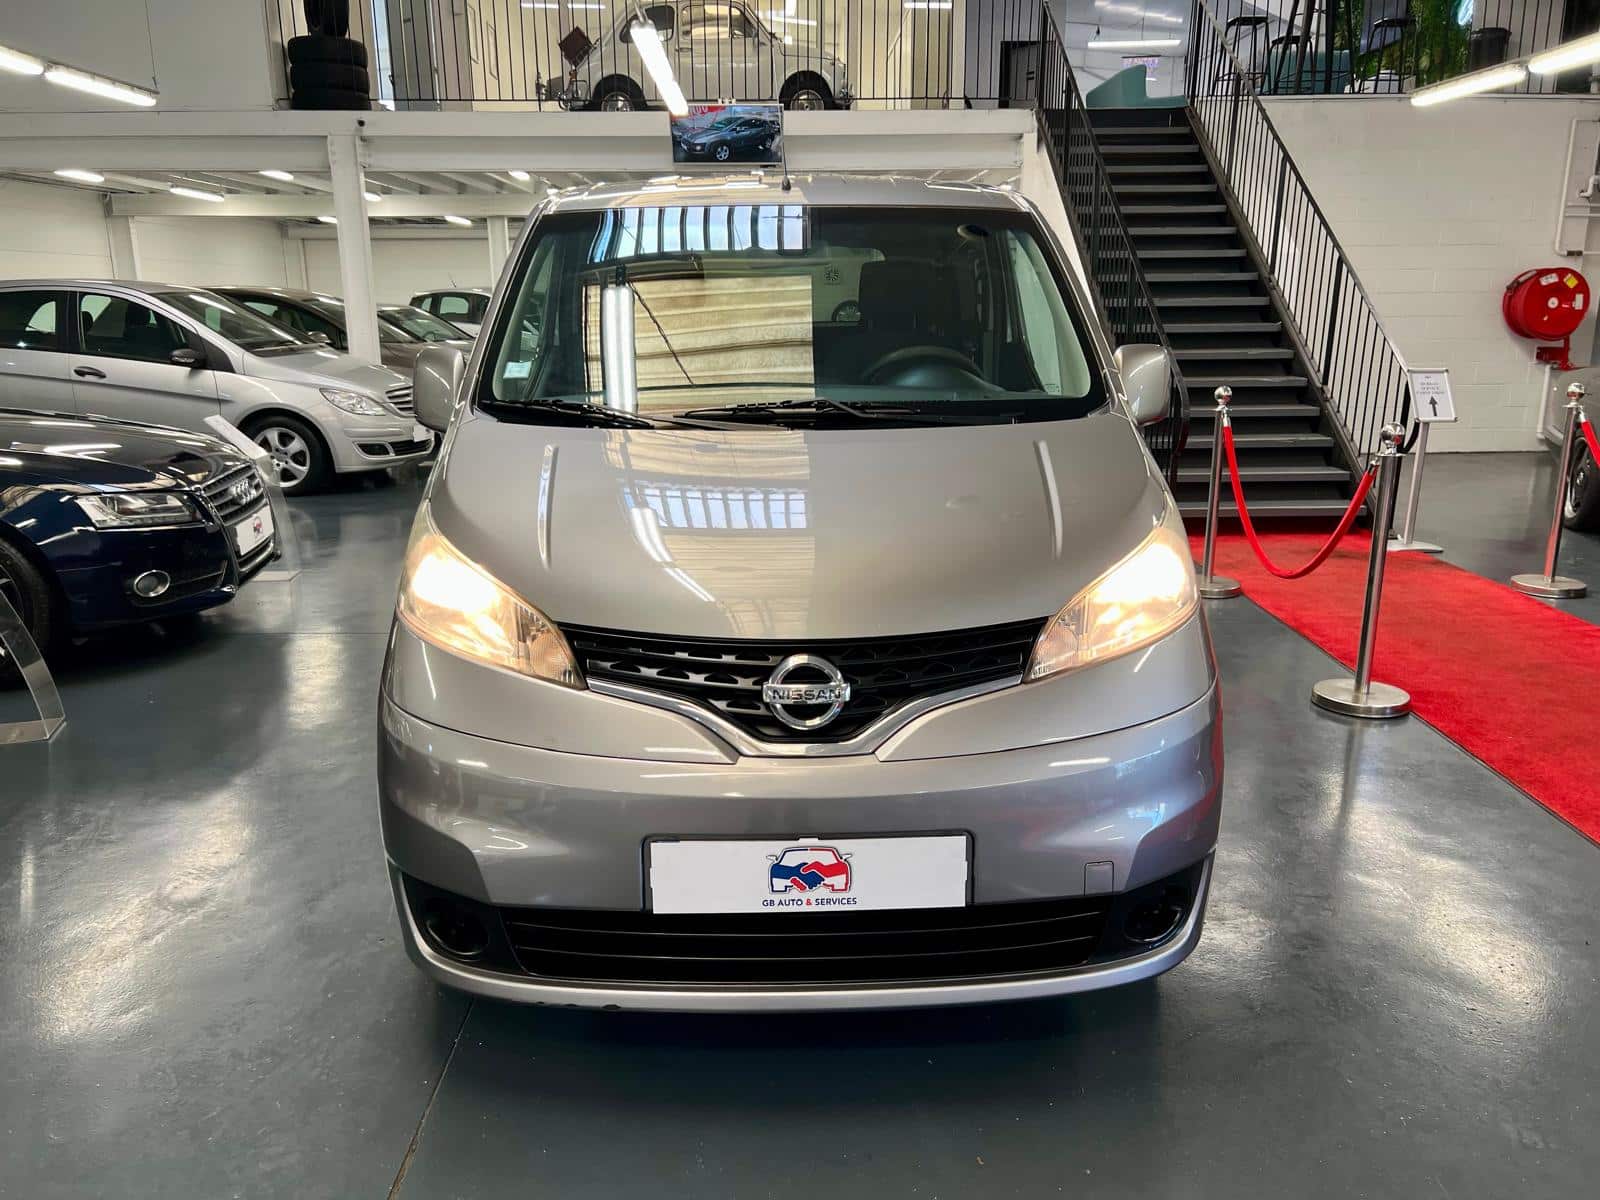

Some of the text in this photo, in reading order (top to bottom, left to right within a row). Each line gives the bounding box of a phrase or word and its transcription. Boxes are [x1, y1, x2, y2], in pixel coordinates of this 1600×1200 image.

[771, 688, 842, 701] NISSAN
[762, 897, 857, 907] GB AUTO & SERVICES
